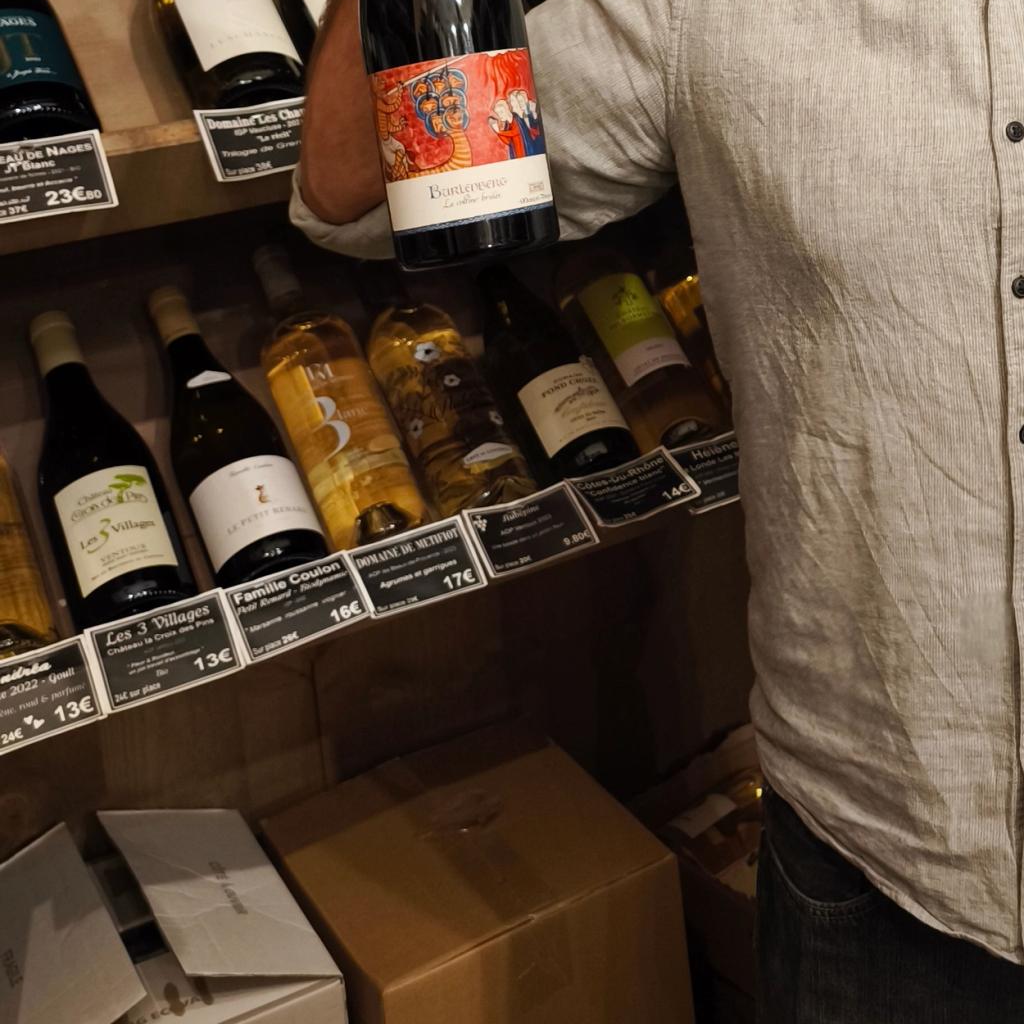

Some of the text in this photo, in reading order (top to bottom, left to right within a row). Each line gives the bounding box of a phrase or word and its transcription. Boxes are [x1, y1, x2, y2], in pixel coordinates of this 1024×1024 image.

[46, 142, 94, 156] NAGES
[355, 545, 401, 569] DOMAINE
[400, 542, 416, 555] DE
[234, 562, 341, 605] Famille Coulon
[442, 568, 477, 591] 17€
[330, 600, 363, 623] 16€
[105, 602, 210, 647] Les 3 Villages
[107, 640, 143, 656] Château
[154, 631, 177, 643] Croix
[193, 647, 234, 671] 13€
[12, 679, 39, 696] 2022
[54, 695, 95, 722] 13€
